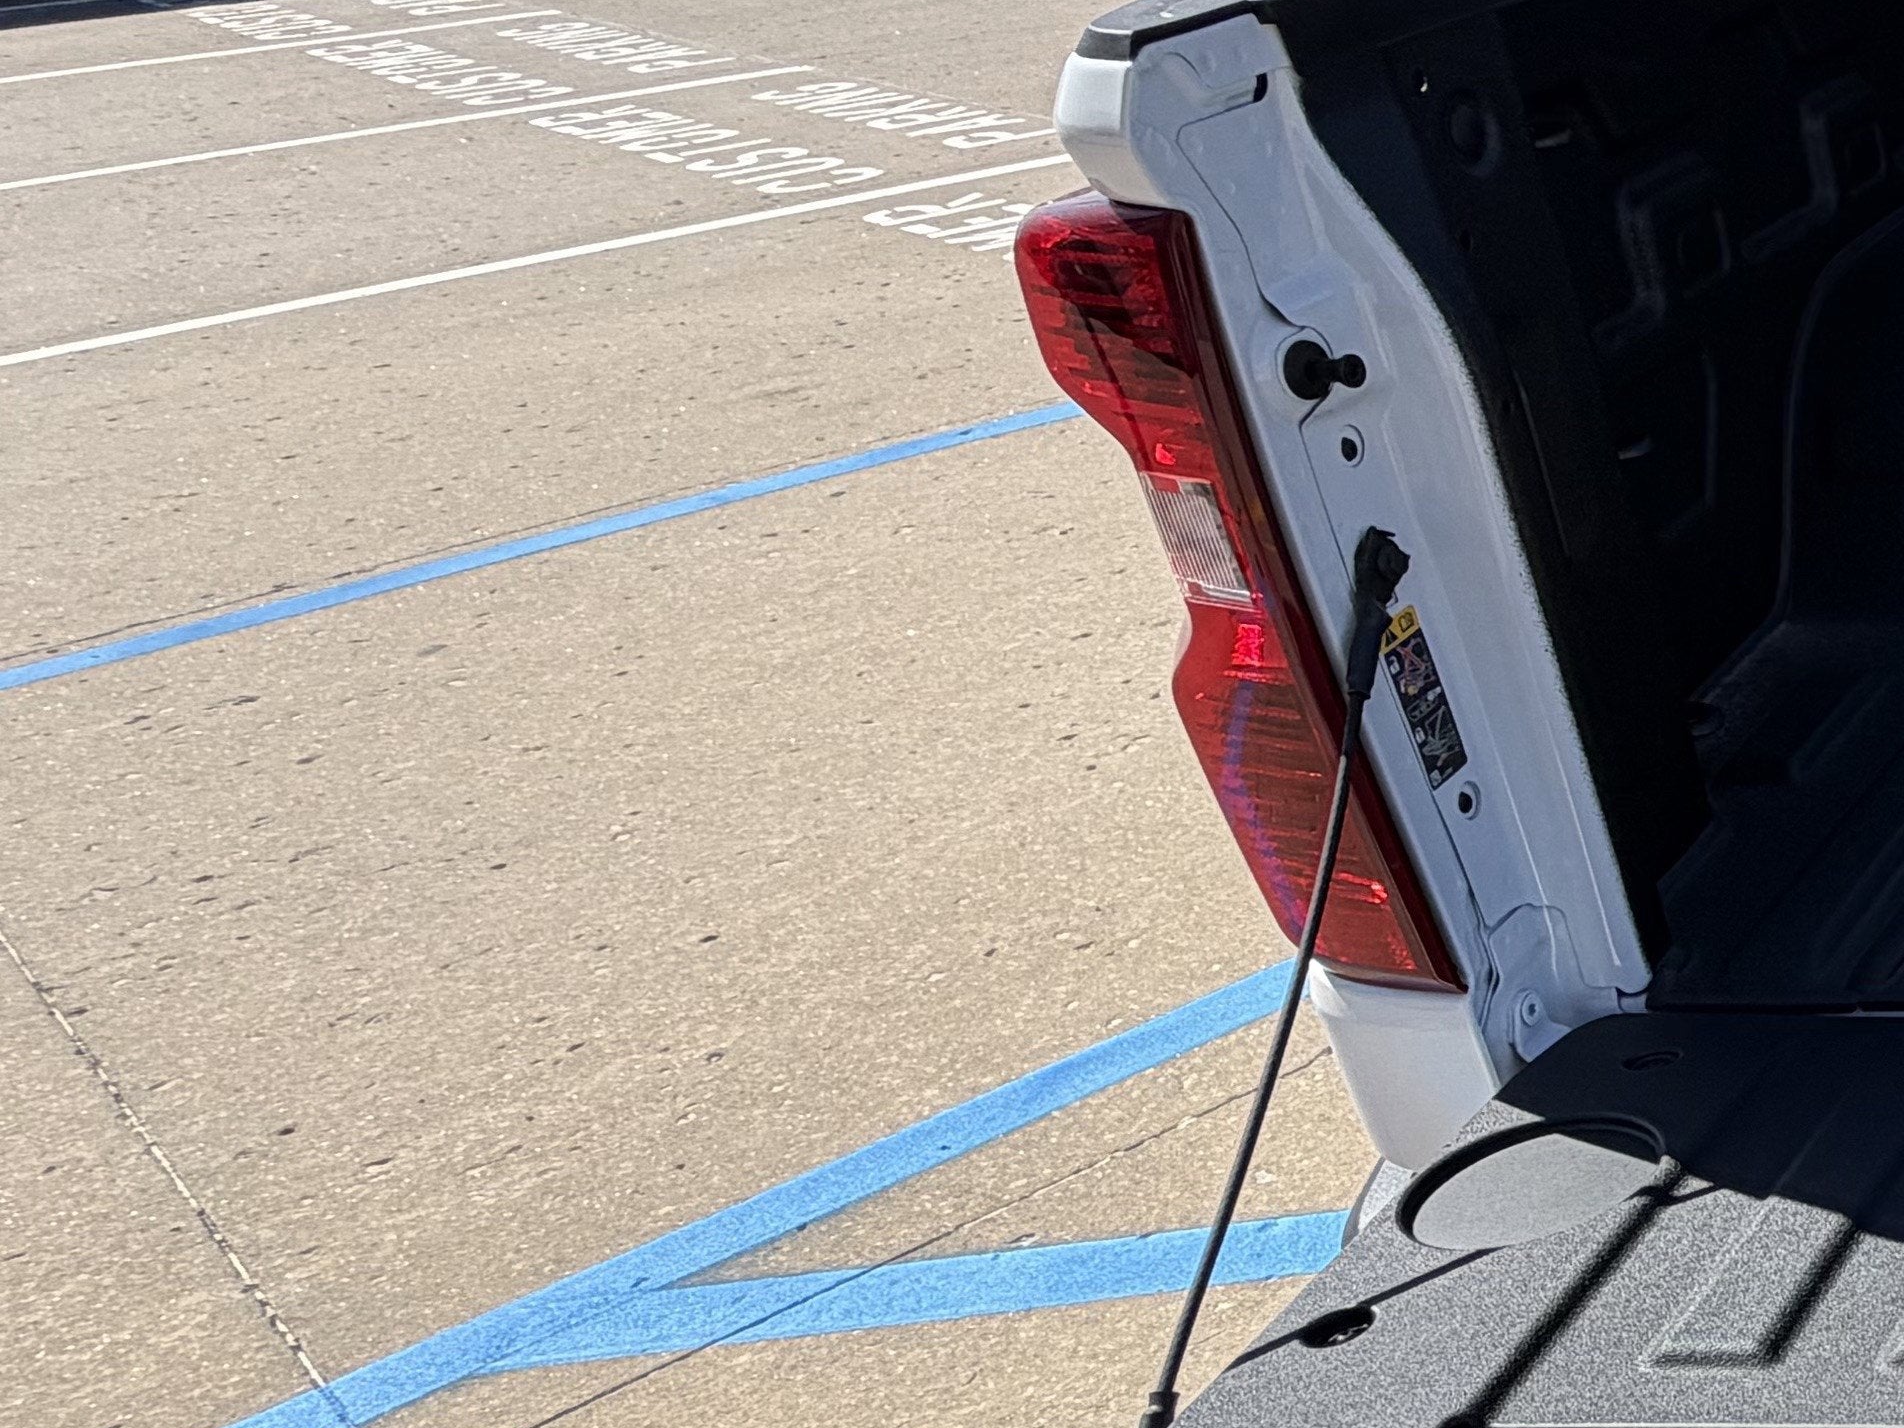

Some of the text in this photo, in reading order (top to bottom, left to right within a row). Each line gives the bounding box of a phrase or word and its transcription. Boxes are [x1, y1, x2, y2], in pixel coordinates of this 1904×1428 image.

[305, 39, 574, 106] CUSTOMER
[497, 22, 736, 73] PARKING
[751, 81, 1058, 149] PARKING
[528, 105, 884, 194] CUSTOMER
